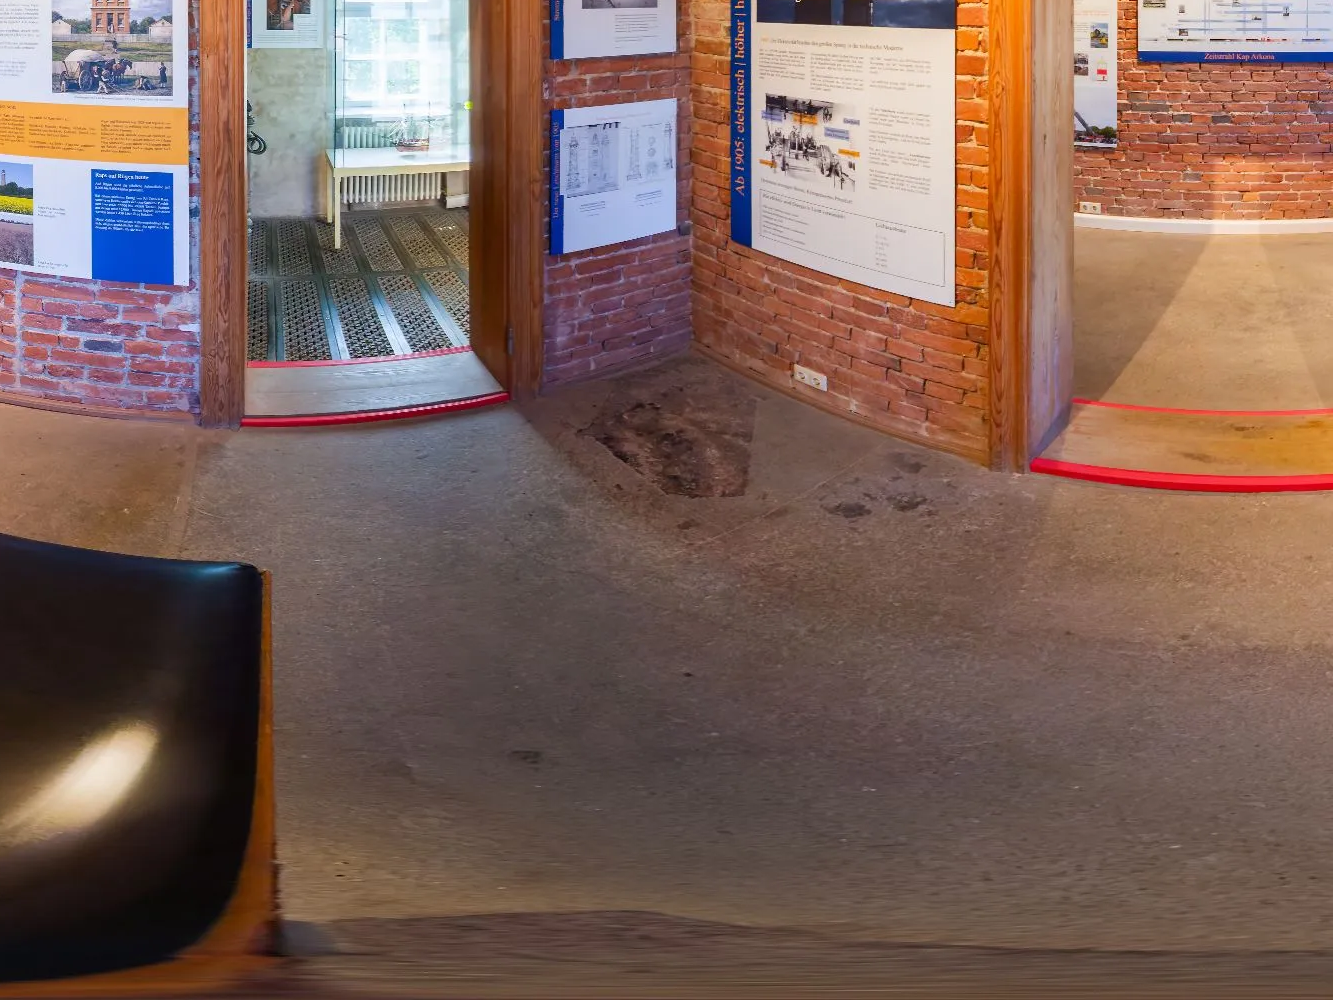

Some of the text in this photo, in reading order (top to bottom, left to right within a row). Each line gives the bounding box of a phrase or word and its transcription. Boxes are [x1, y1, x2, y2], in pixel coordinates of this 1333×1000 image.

[735, 19, 744, 58] höher
[1236, 53, 1250, 62] Kap
[734, 68, 744, 133] elektrisch
[735, 137, 744, 171] 1905:
[735, 177, 744, 196] Ab
